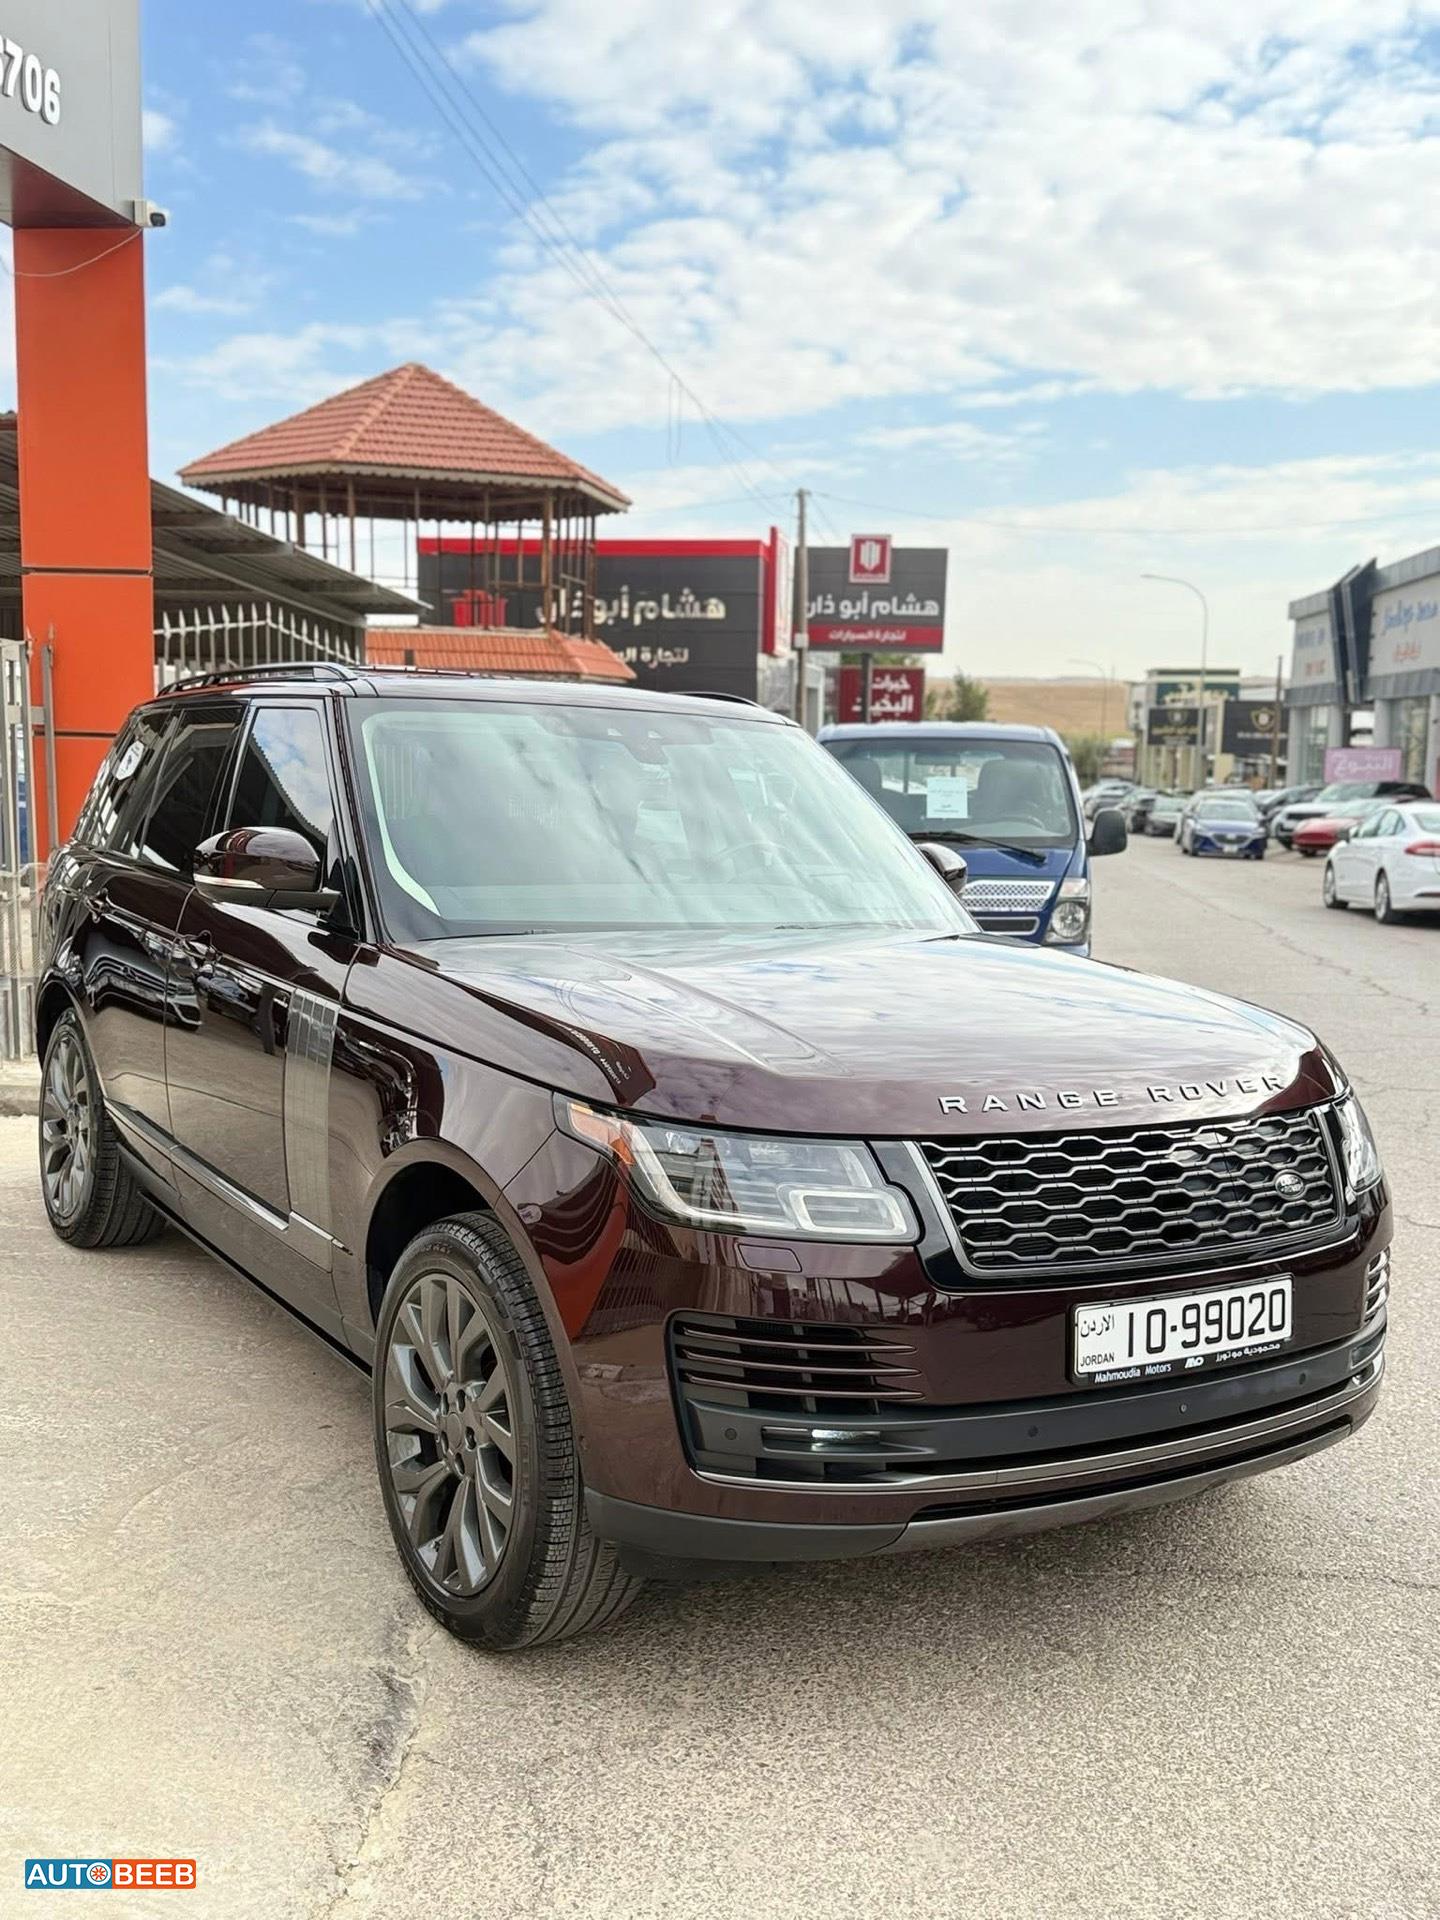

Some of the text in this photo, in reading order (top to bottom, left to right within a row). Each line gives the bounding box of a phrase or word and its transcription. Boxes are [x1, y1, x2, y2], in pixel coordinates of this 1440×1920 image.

[0, 34, 61, 125] 706
[593, 584, 629, 625] أبو
[634, 587, 726, 626] هشام
[840, 590, 868, 620] أبو
[870, 592, 940, 620] هشام
[640, 645, 689, 669] لتجارة
[938, 1074, 1286, 1115] RANGE ROVER
[1126, 1287, 1286, 1359] 10-99020
[1079, 1351, 1115, 1367] JORDAN
[1094, 1366, 1141, 1384] Mahmoudia
[1144, 1353, 1173, 1376] Motors
